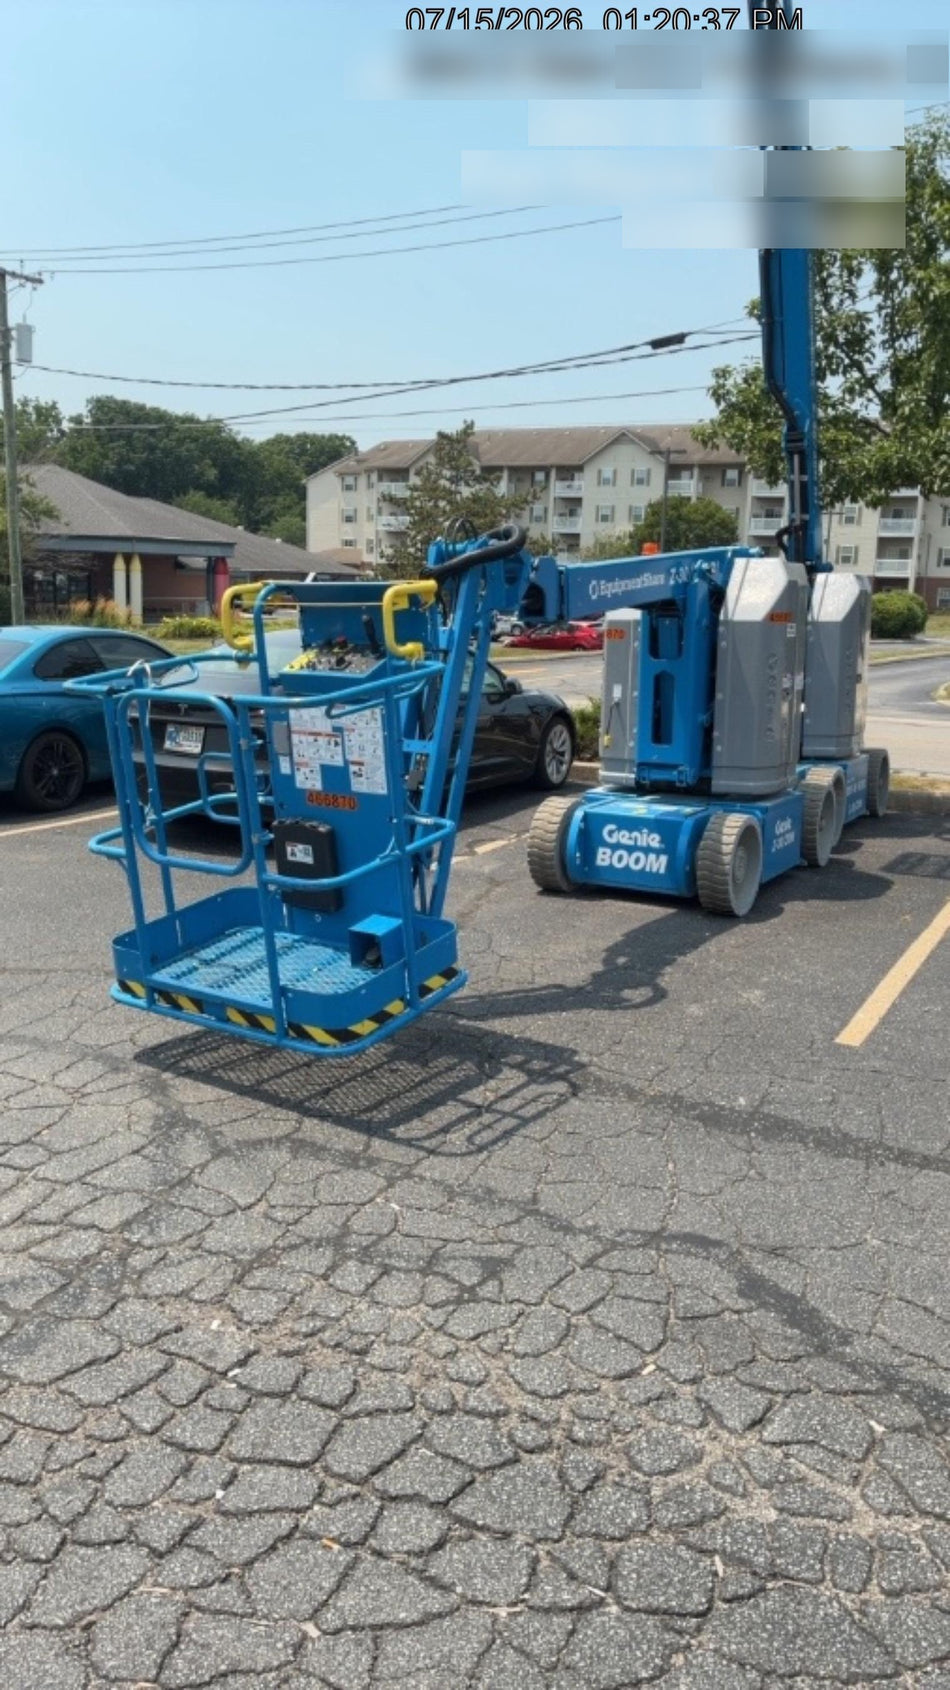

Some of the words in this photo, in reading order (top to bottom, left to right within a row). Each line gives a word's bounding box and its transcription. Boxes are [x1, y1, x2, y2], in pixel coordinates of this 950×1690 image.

[600, 573, 665, 598] EquipmentShare
[307, 791, 357, 810] 466870
[602, 823, 662, 848] Genie
[595, 846, 669, 874] BOOM
